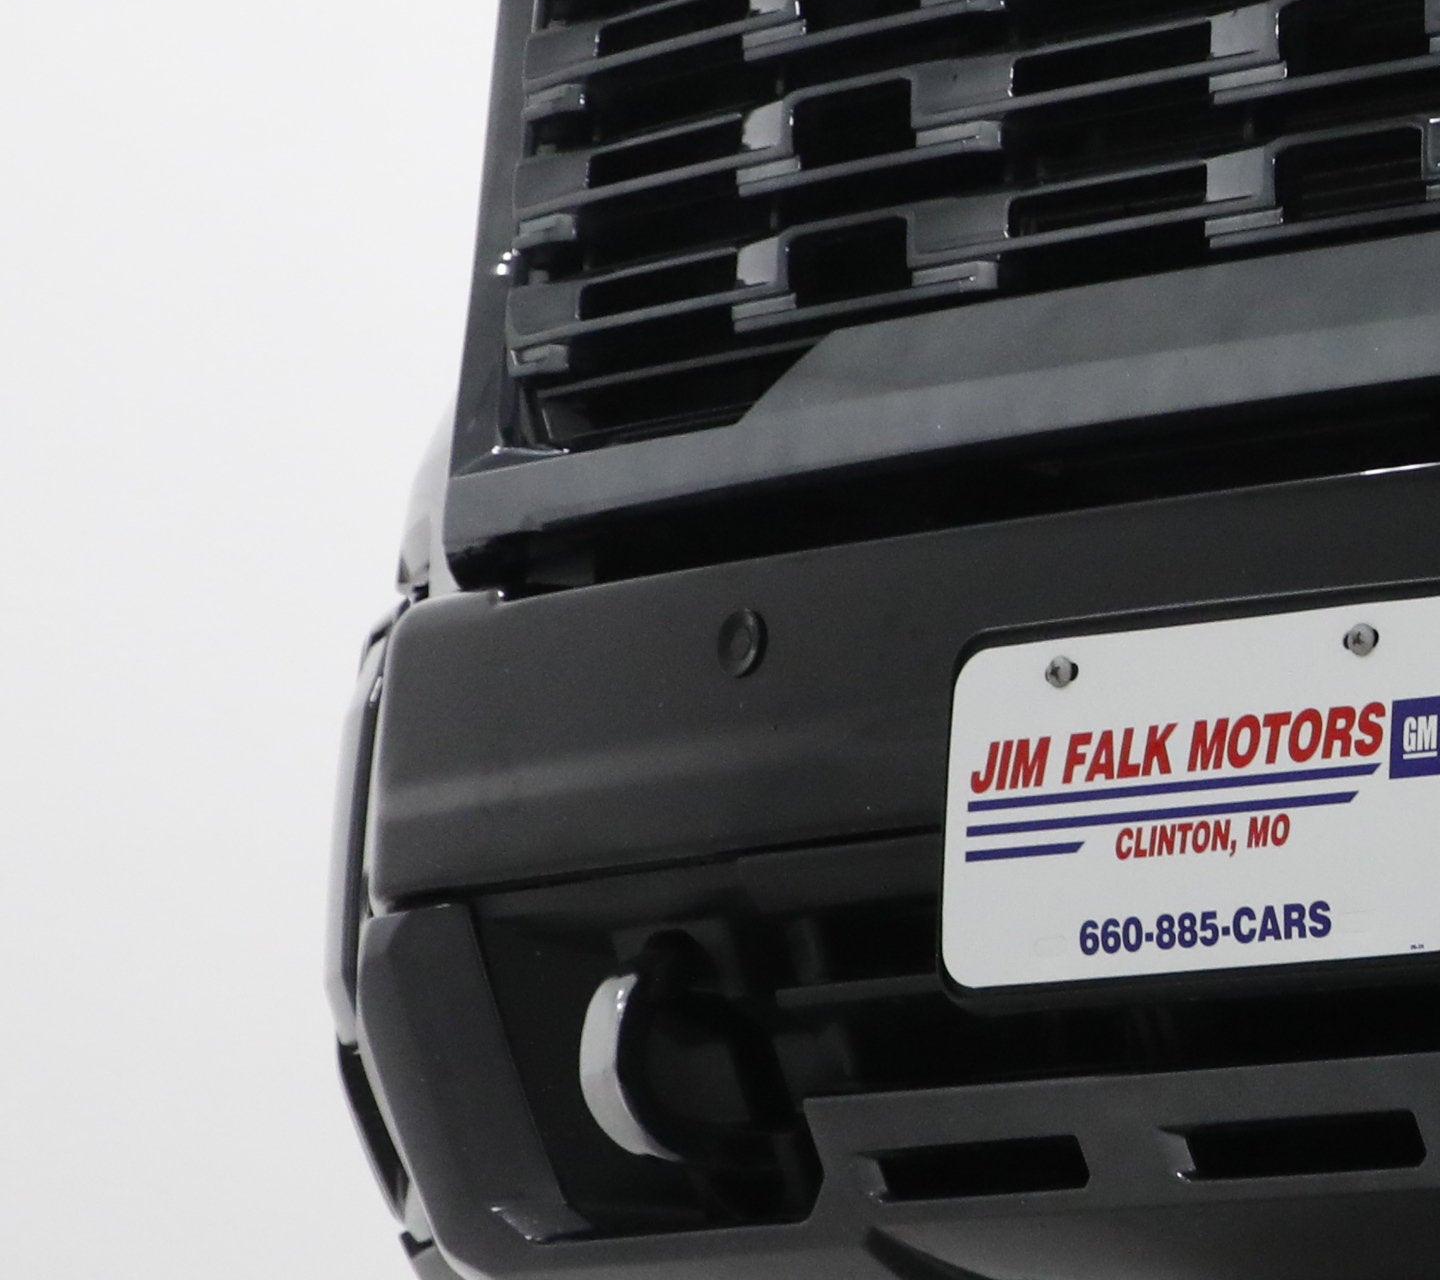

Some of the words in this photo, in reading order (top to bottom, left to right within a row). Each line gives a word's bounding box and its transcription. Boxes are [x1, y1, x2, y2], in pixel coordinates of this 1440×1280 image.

[970, 737, 1051, 794] JIM
[1062, 724, 1177, 784] FALK
[1187, 702, 1386, 772] MOTORS
[1402, 714, 1439, 753] GM
[1115, 819, 1238, 860] CLINTON,
[1247, 813, 1290, 848] MO
[1079, 900, 1332, 955] 660-885-CARS
